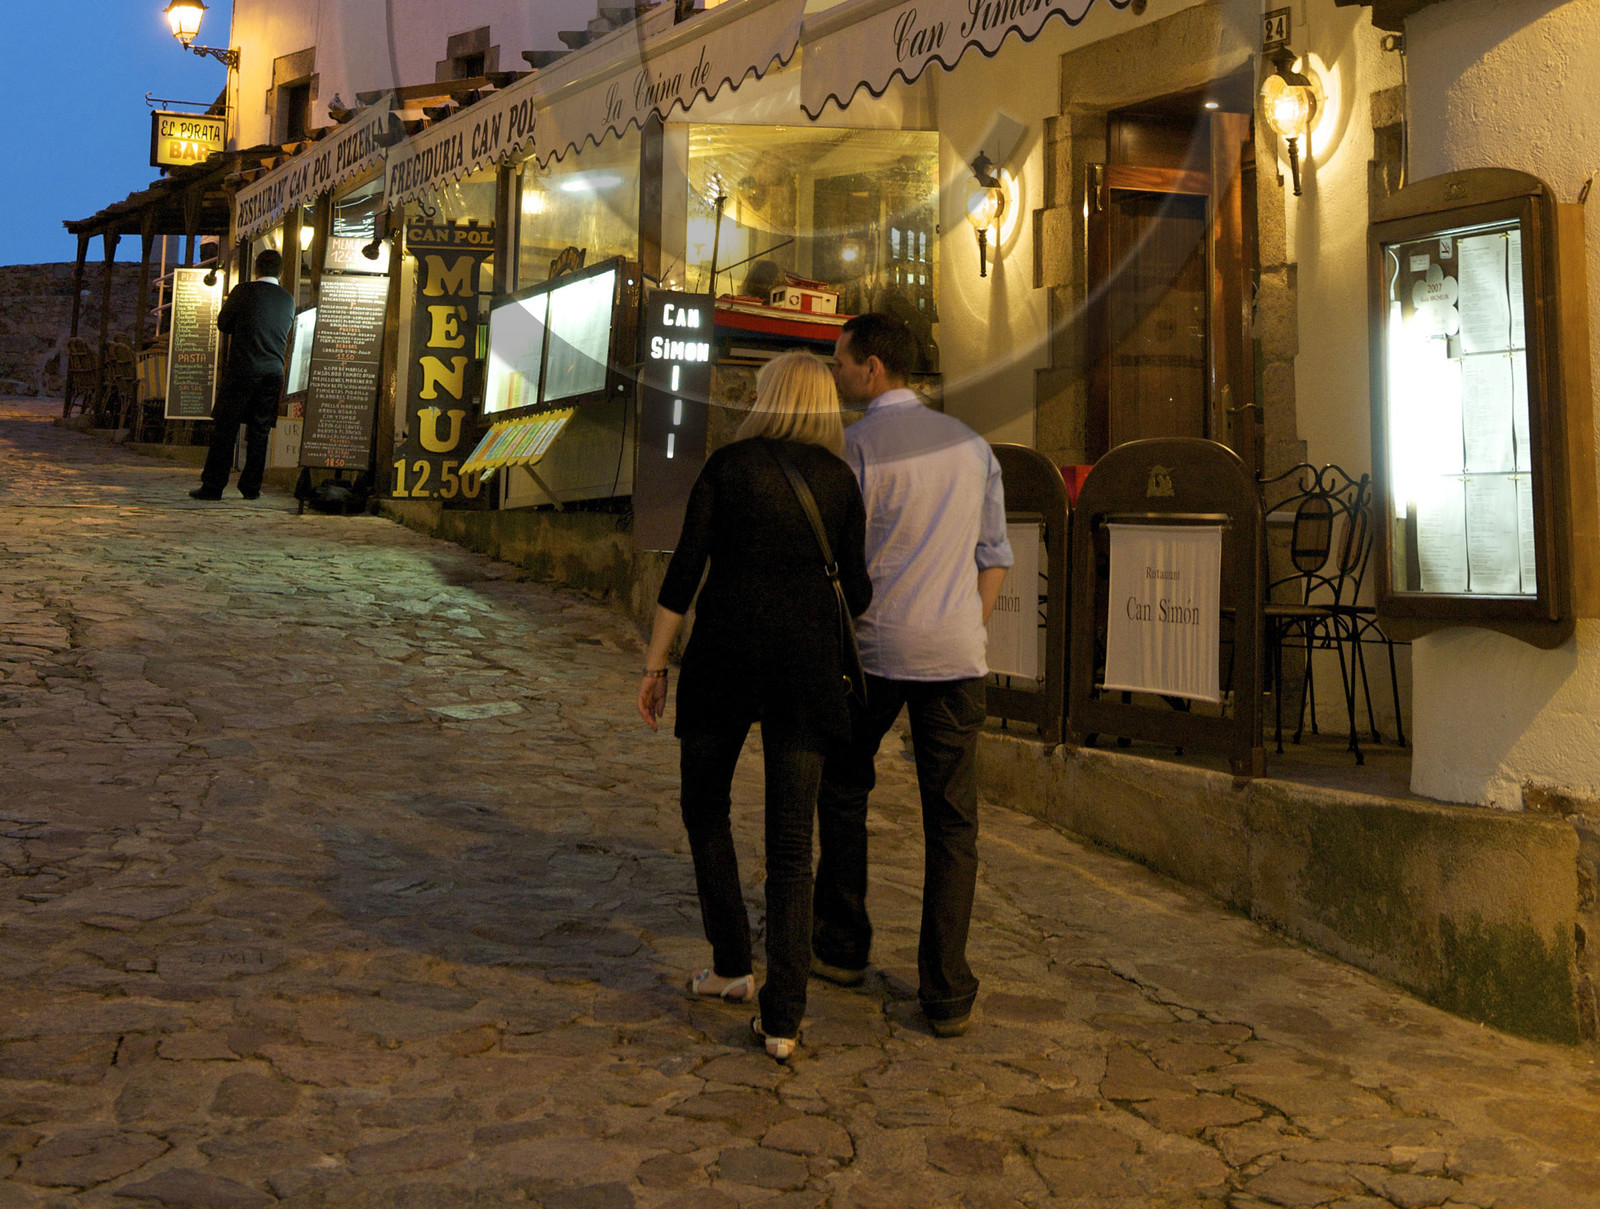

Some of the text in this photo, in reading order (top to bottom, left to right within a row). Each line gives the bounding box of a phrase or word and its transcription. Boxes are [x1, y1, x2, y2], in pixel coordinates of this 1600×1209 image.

[893, 8, 950, 62] Can
[1265, 17, 1284, 42] 24
[602, 45, 712, 126] La Cuina de
[161, 120, 221, 141] EL PIRATA
[169, 141, 209, 160] BAR
[389, 97, 536, 197] FREGIDURIA CAN POL
[237, 116, 385, 228] RESTAURANT CAN POL PIZZERIA
[408, 229, 494, 244] CAN POL
[1427, 283, 1442, 293] 2007
[178, 353, 207, 363] PASTA
[422, 255, 475, 453] MENU
[392, 459, 481, 498] 12.50
[1126, 596, 1200, 625] Can Simón
